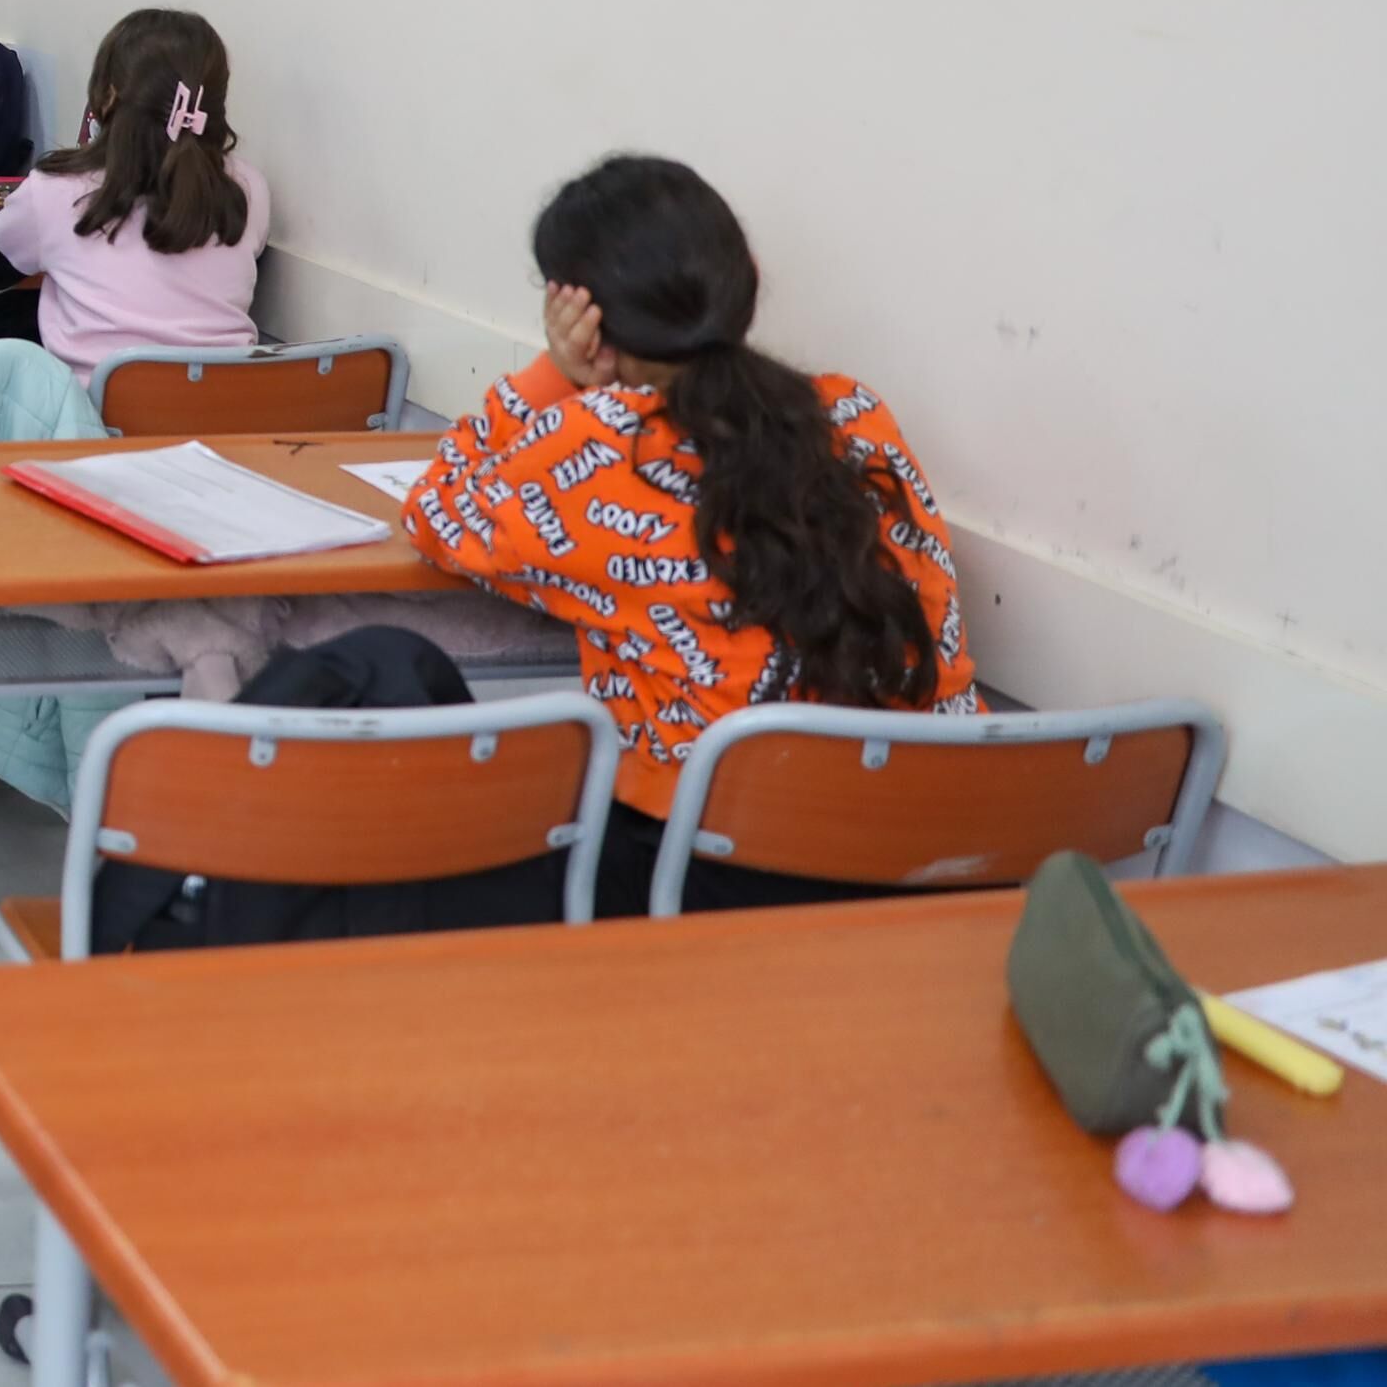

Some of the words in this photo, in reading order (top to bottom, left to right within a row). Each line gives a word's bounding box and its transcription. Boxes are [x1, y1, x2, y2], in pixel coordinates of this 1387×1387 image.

[519, 482, 577, 557] EXCITED
[586, 497, 679, 544] GOOFY
[607, 553, 709, 587] EXCITED
[648, 604, 726, 687] SHOCKED
